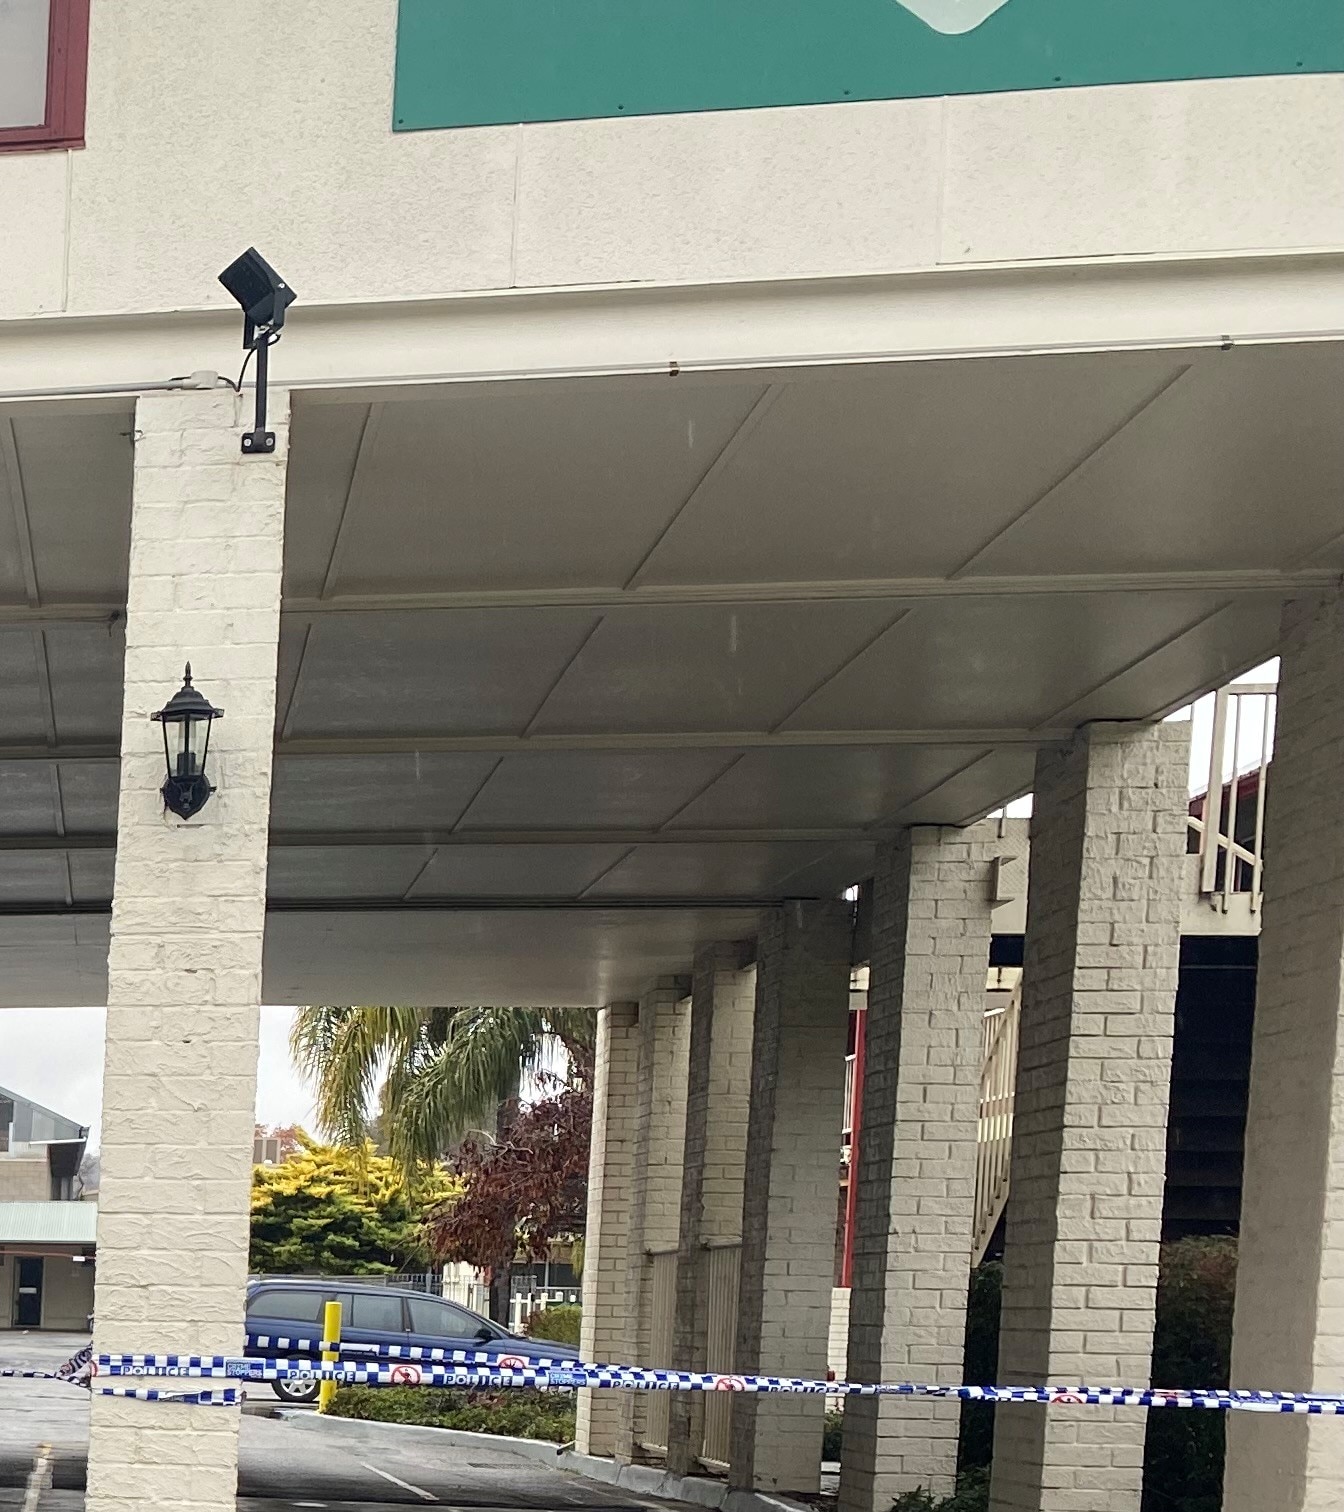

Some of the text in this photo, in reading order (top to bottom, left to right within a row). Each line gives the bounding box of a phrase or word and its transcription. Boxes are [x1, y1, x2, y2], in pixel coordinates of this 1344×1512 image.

[121, 1365, 189, 1377] POLICE
[289, 1371, 355, 1382] POLICE
[445, 1375, 511, 1387] POLICE
[612, 1380, 679, 1390] POLICE
